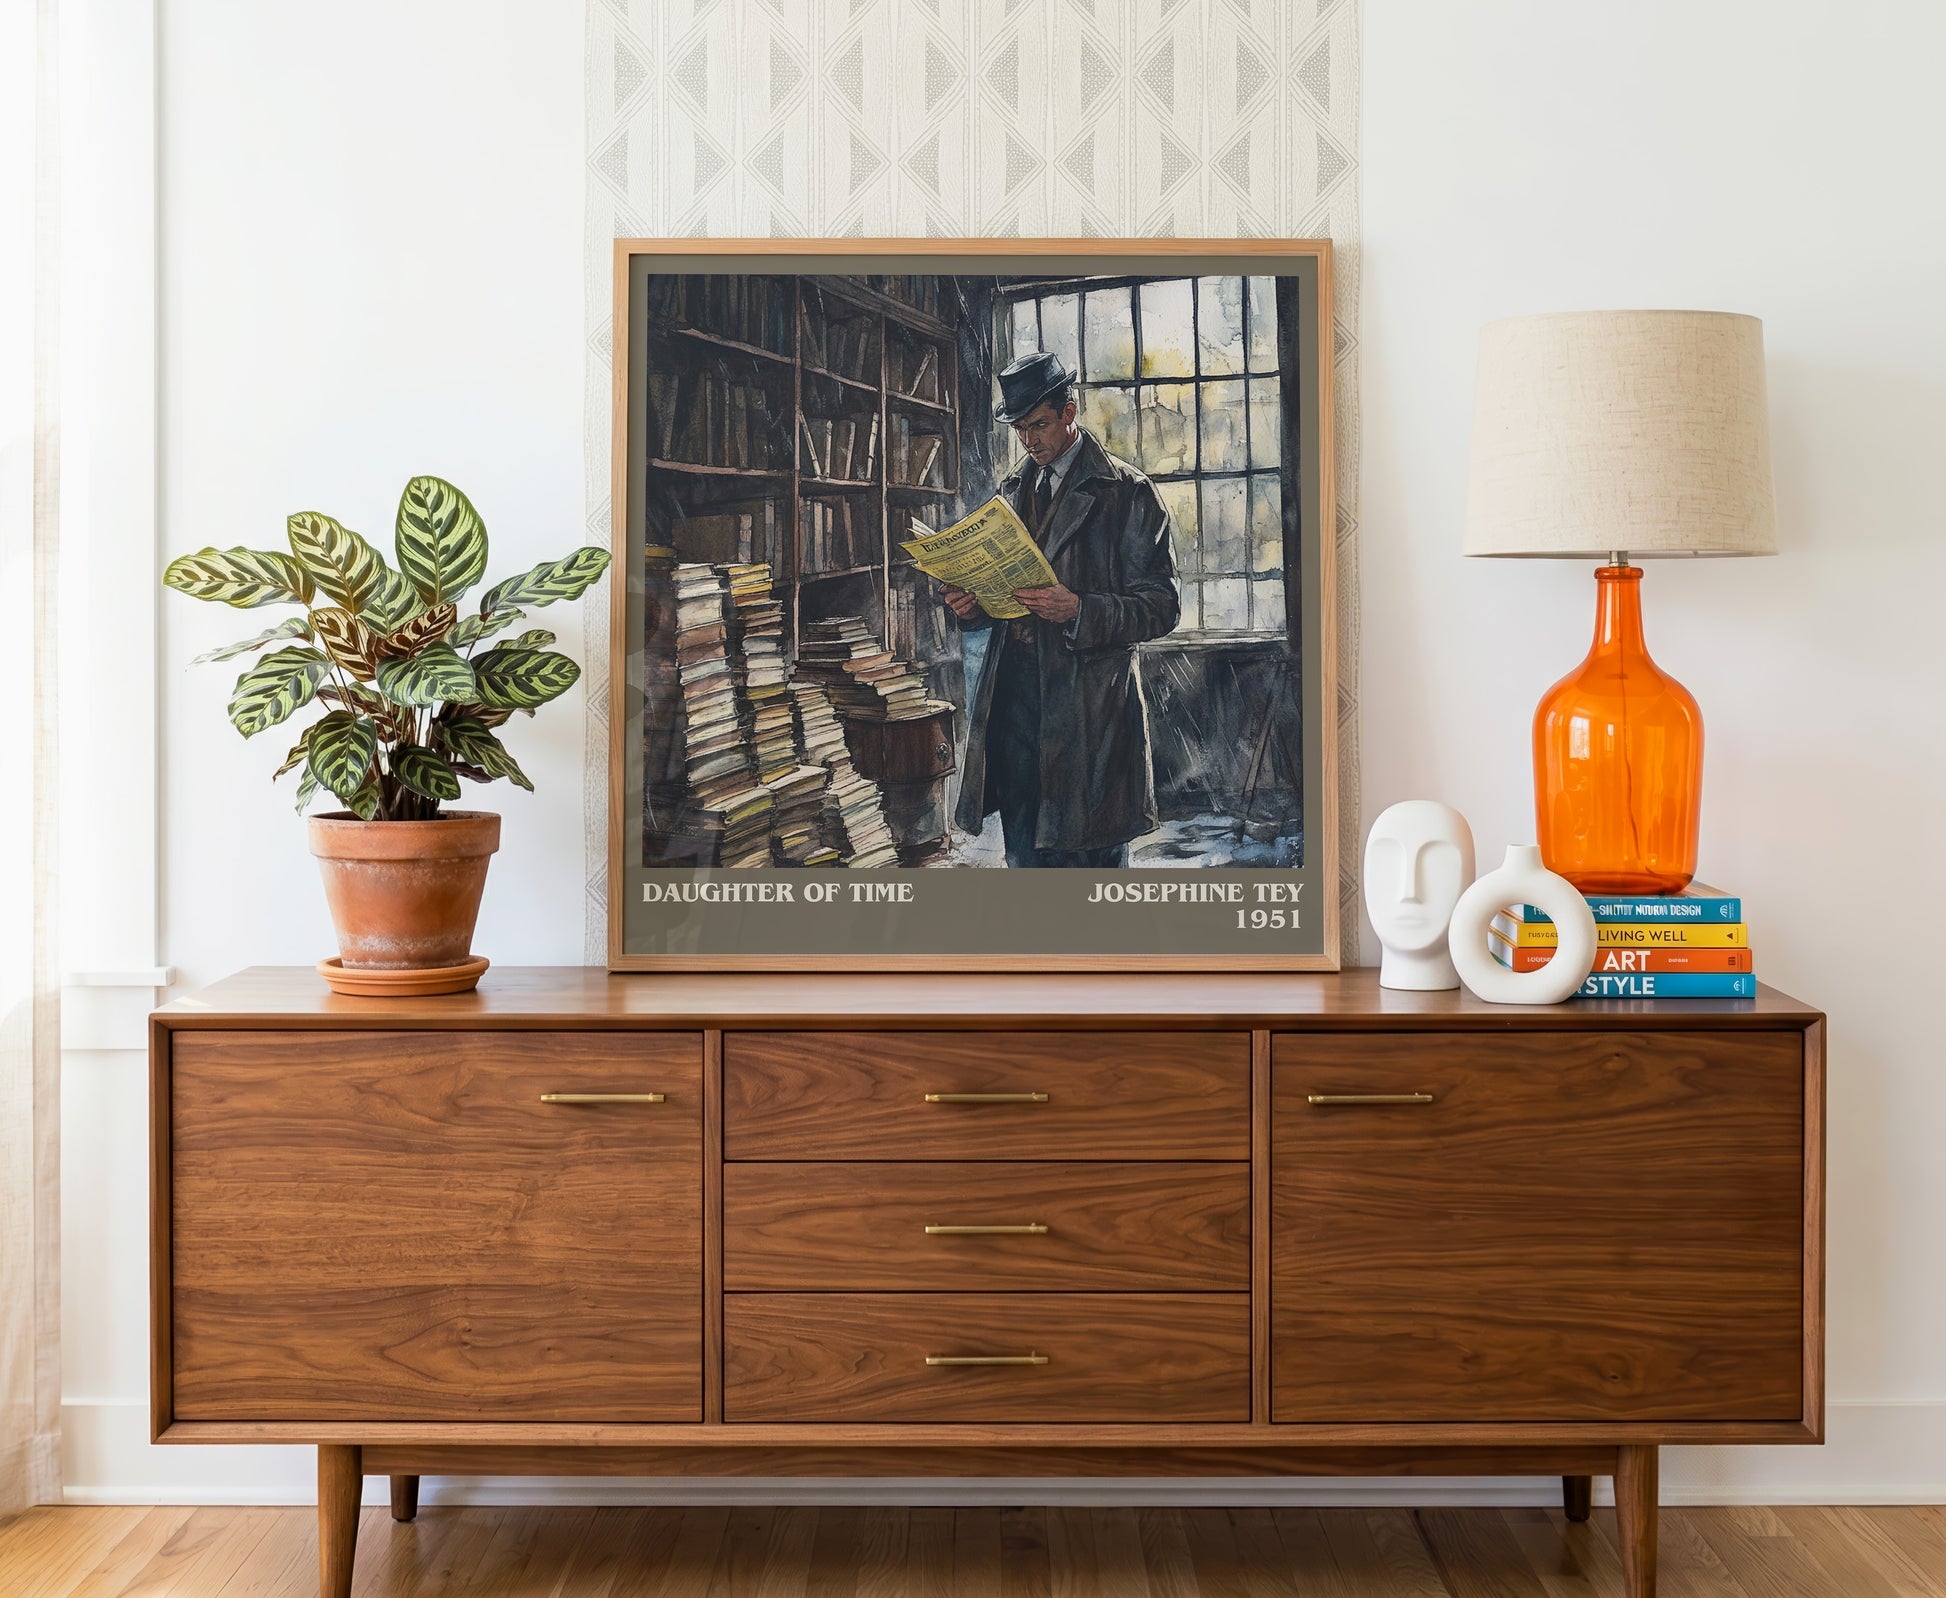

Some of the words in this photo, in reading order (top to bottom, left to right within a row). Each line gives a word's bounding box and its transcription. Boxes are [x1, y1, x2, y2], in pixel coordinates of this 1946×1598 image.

[642, 882, 795, 903] DAUGHTER
[803, 882, 841, 903] OF
[848, 883, 915, 903] TIME
[1087, 882, 1244, 903] JOSEPHINE
[1252, 883, 1305, 903] TEY
[1236, 909, 1301, 929] 1951
[1670, 904, 1702, 916] DESIGN
[1598, 930, 1645, 941] LIVING
[1649, 930, 1687, 941] WELL
[1603, 951, 1651, 971] ART
[1585, 976, 1655, 995] STYLE
